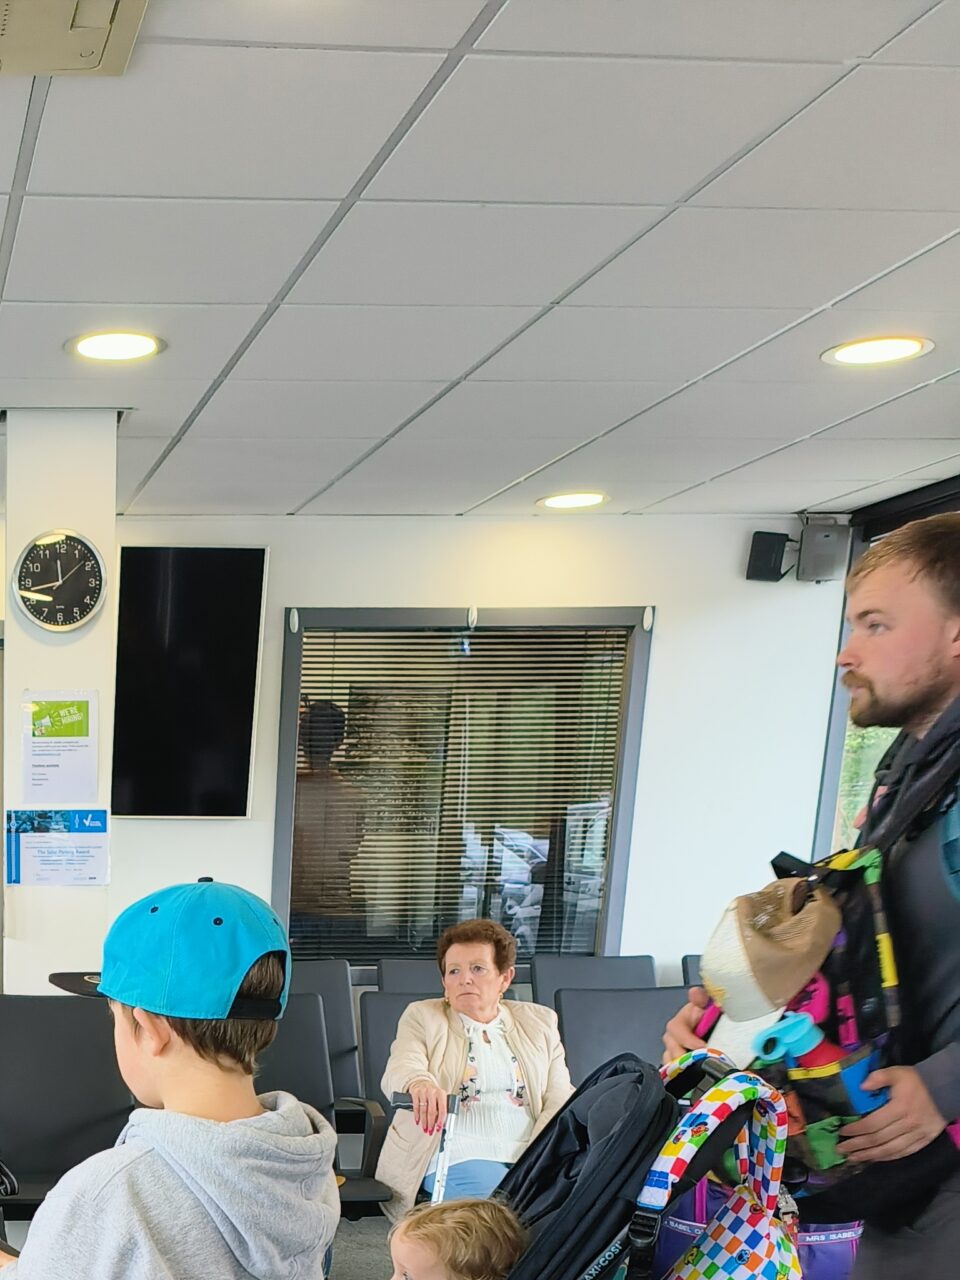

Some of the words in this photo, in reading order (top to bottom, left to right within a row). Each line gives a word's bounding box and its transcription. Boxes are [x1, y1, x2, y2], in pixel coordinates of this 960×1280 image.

[55, 544, 67, 553] 12
[39, 550, 50, 559] 11
[74, 550, 79, 558] 1
[28, 563, 40, 572] 10
[85, 562, 91, 571] 2
[25, 578, 32, 587] 9
[88, 578, 95, 587] 3
[83, 595, 90, 604] 4
[42, 608, 49, 616] 7
[73, 607, 80, 616] 5
[56, 612, 63, 621] 6
